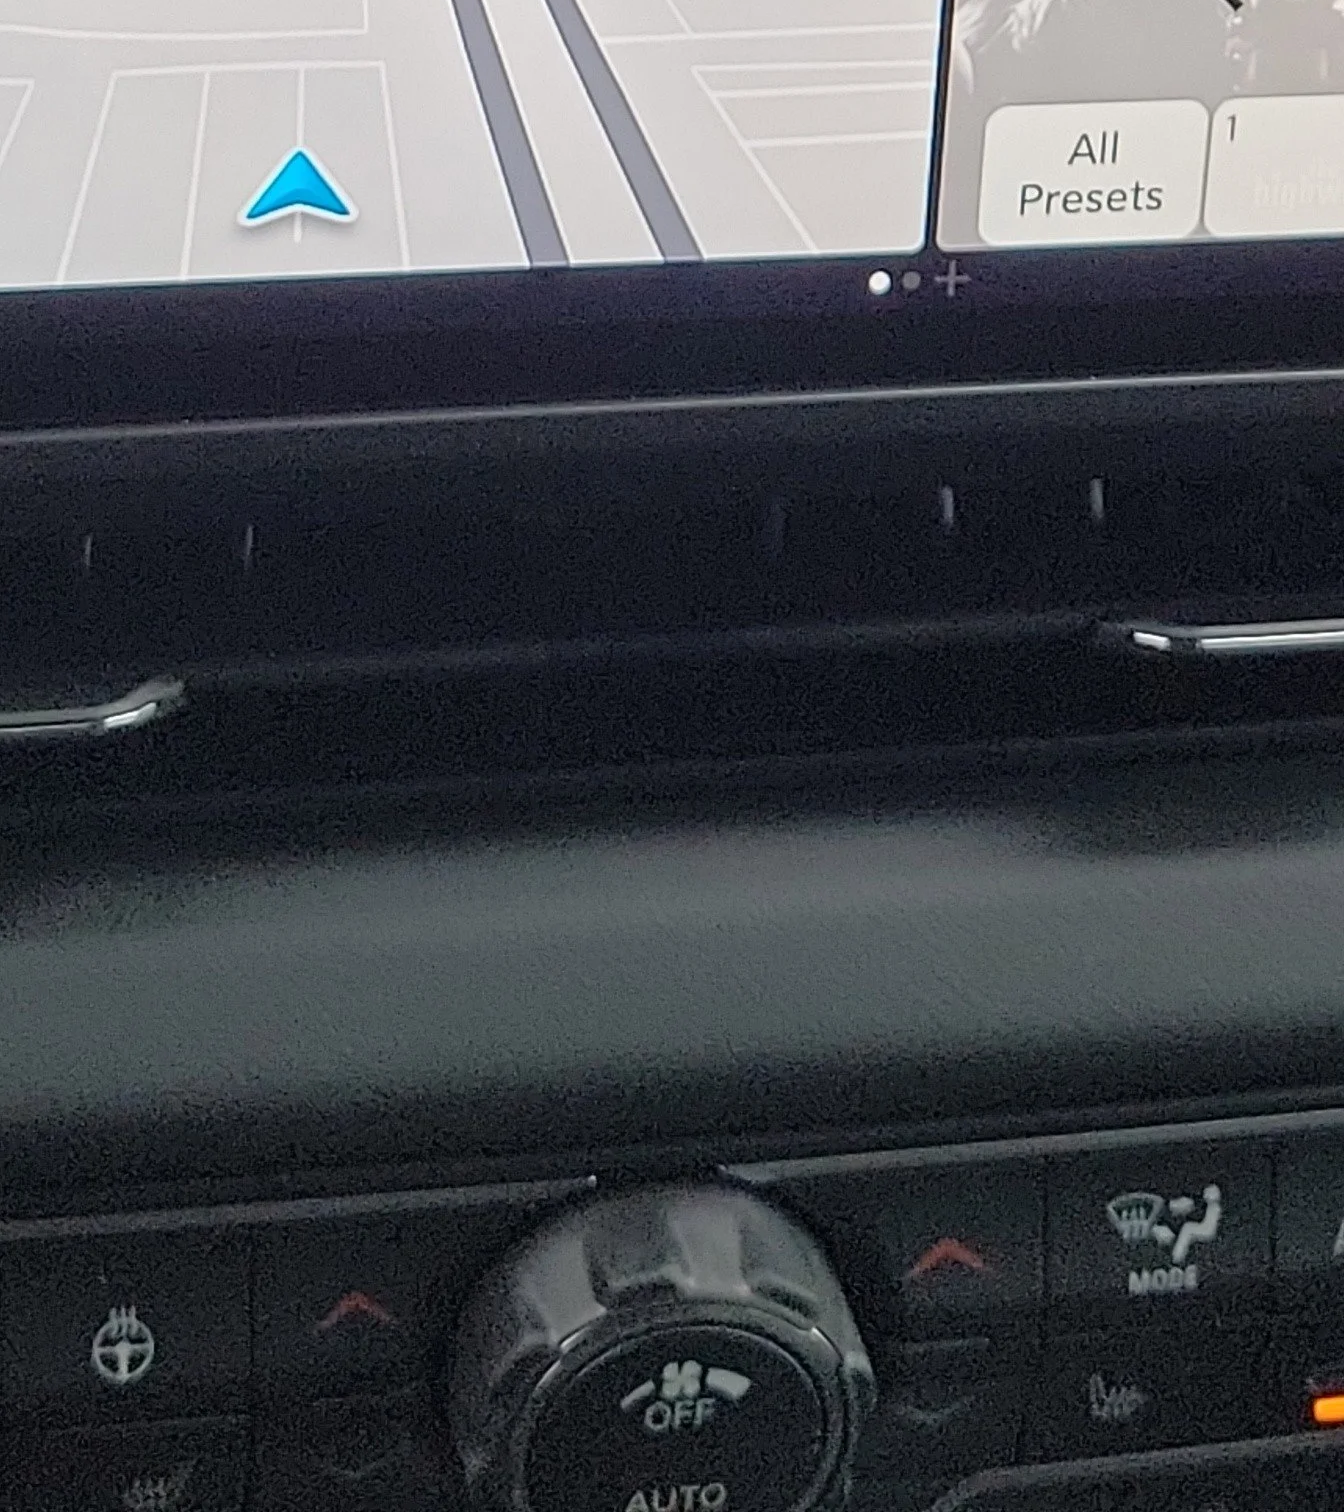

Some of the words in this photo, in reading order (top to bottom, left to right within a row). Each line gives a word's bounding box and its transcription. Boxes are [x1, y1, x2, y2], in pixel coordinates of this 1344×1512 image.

[1227, 114, 1236, 142] 1
[1067, 130, 1119, 165] All
[1019, 181, 1163, 215] Presets
[644, 1398, 716, 1430] OFF
